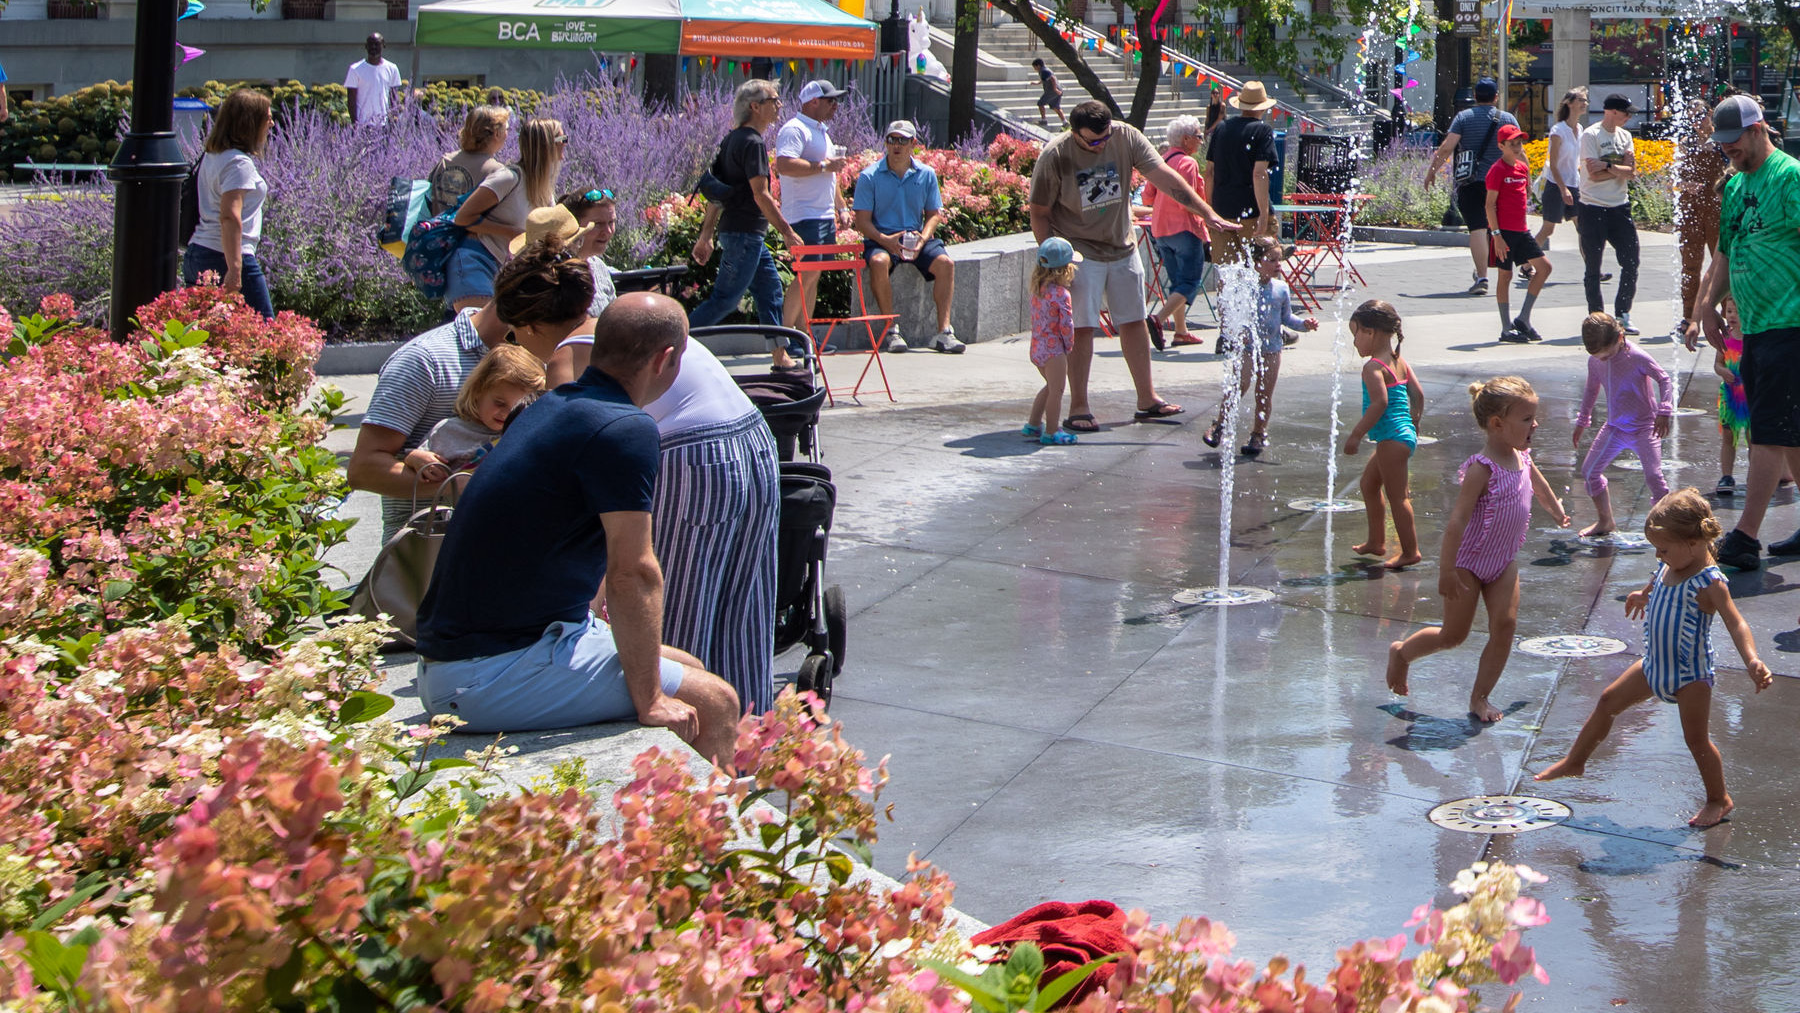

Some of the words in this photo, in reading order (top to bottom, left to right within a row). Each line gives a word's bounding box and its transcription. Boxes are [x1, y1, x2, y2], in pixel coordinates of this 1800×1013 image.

[1459, 2, 1476, 12] ONLY
[565, 21, 585, 31] LOVE
[498, 21, 540, 42] BCA
